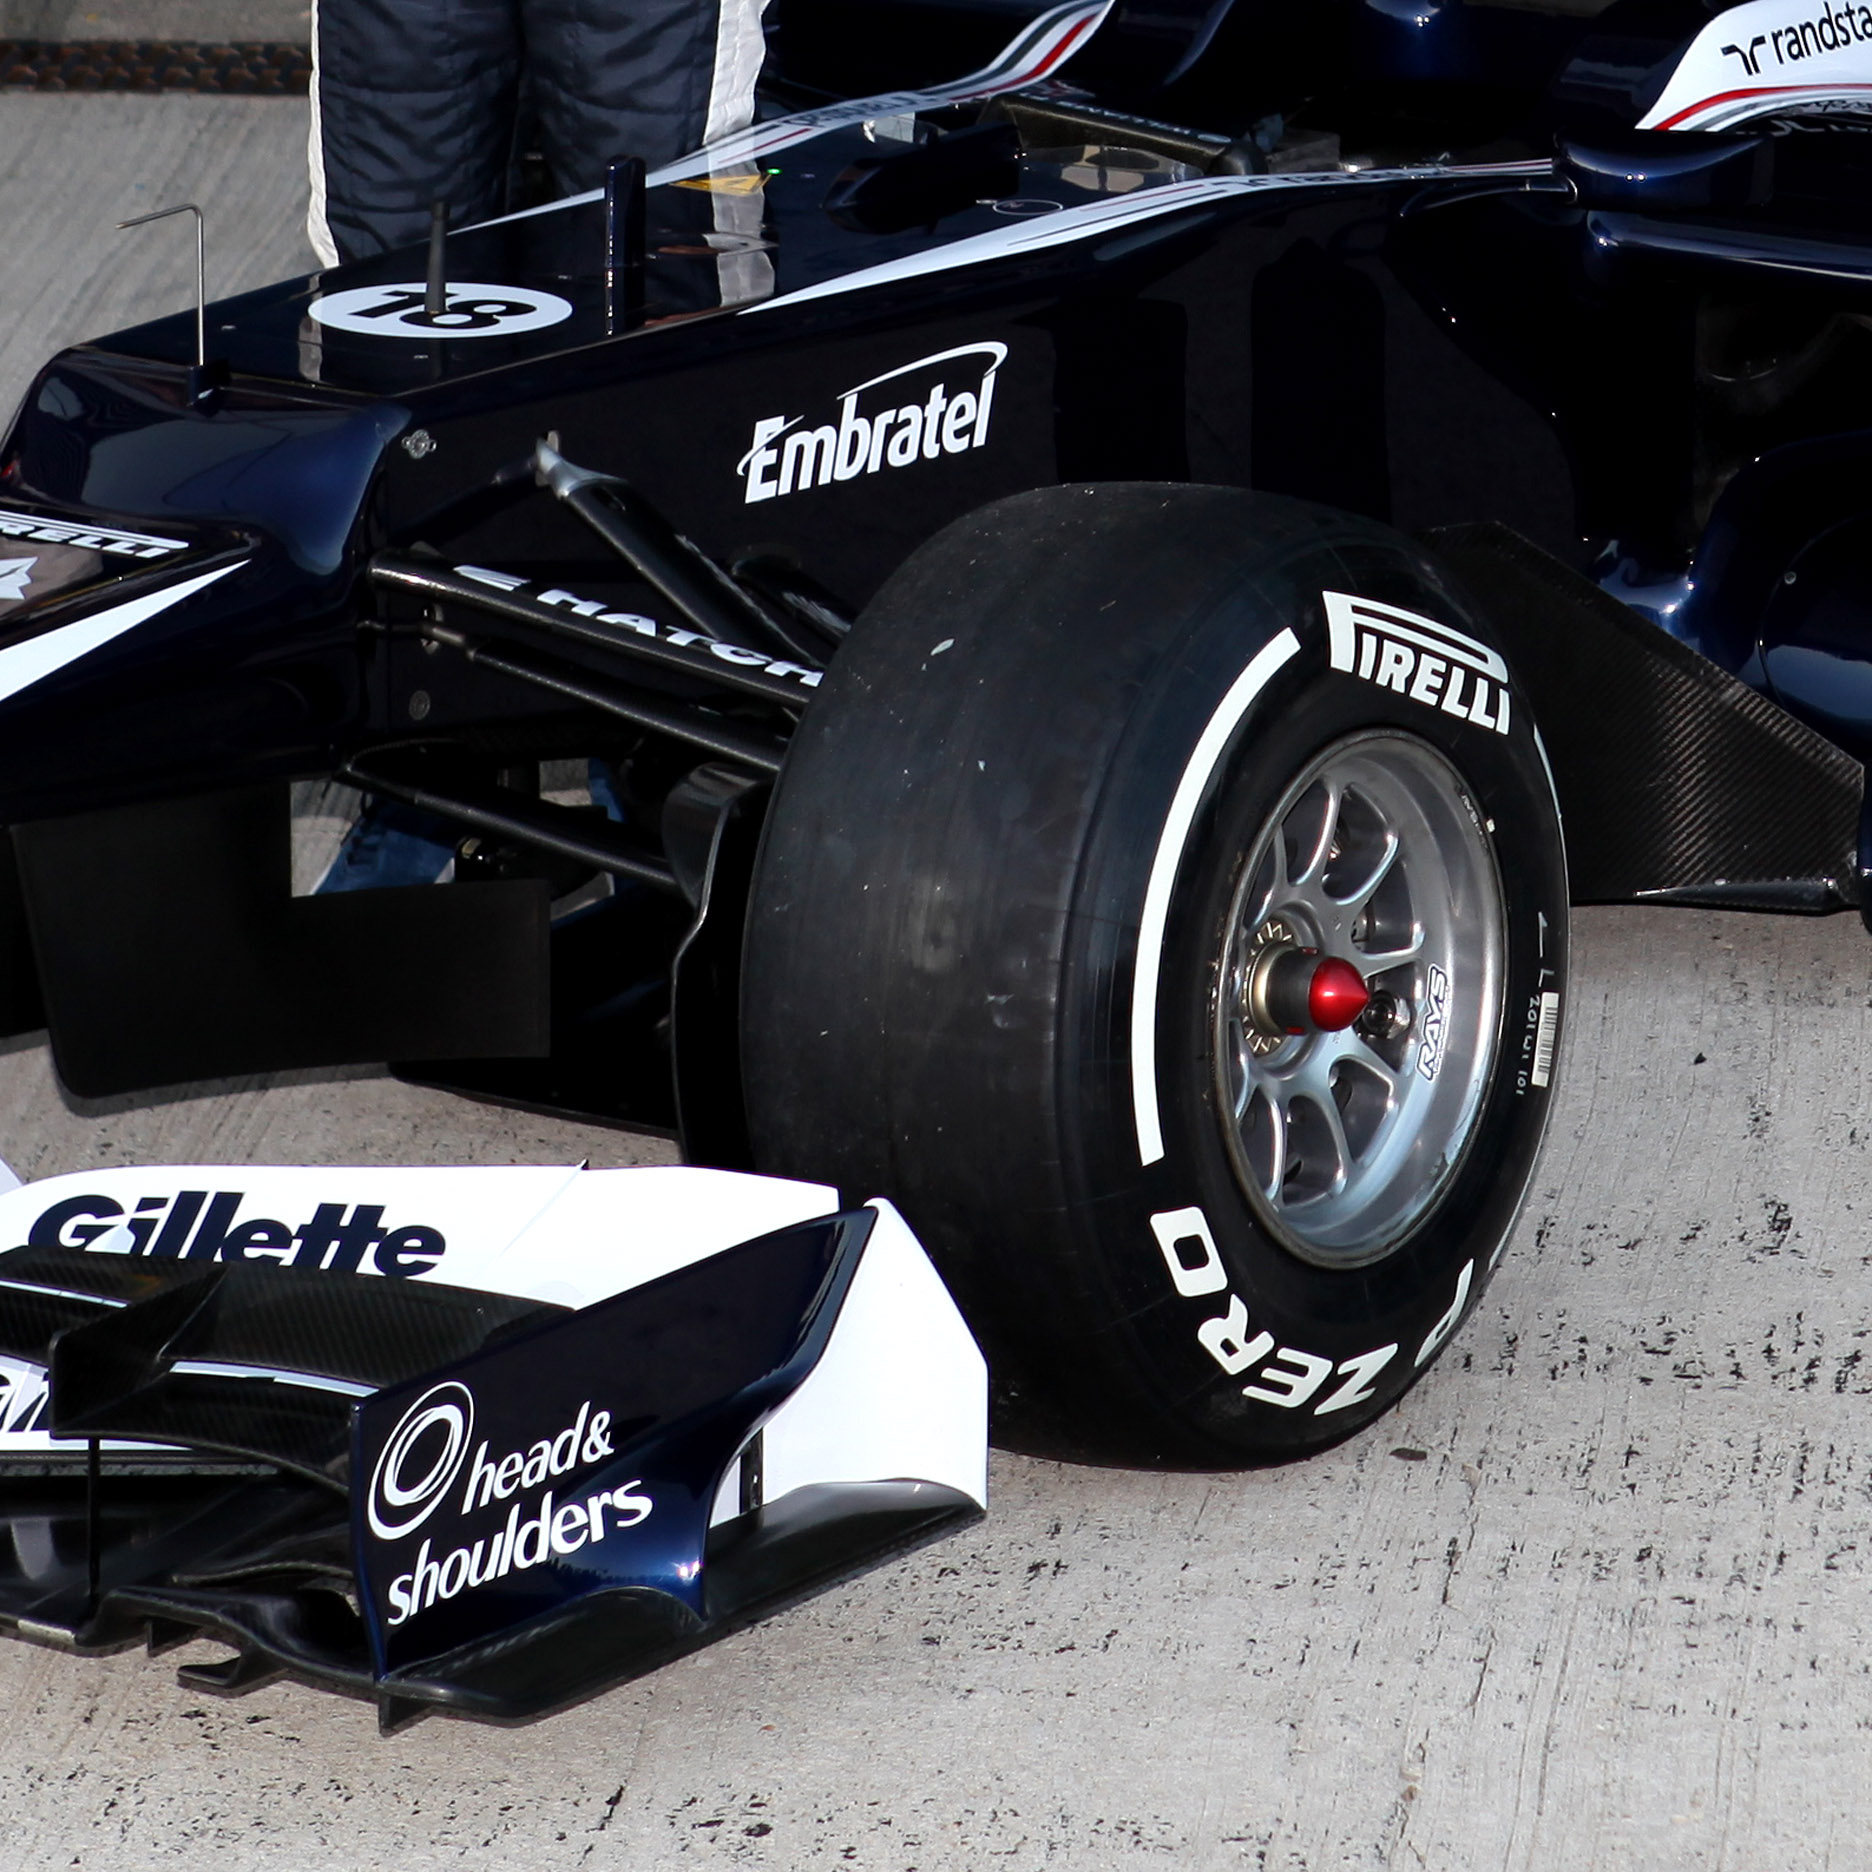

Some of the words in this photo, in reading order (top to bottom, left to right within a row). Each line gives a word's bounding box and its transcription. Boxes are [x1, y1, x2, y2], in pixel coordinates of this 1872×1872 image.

[346, 290, 538, 330] 18
[737, 342, 1008, 504] Embratel
[537, 588, 824, 688] HATCH
[1322, 590, 1511, 737] PIRELLI
[1417, 966, 1447, 1081] RAYS
[28, 1190, 447, 1278] Gillette
[1149, 1205, 1399, 1417] ZERO
[461, 1400, 615, 1515] head&
[387, 1480, 654, 1626] shoulders
